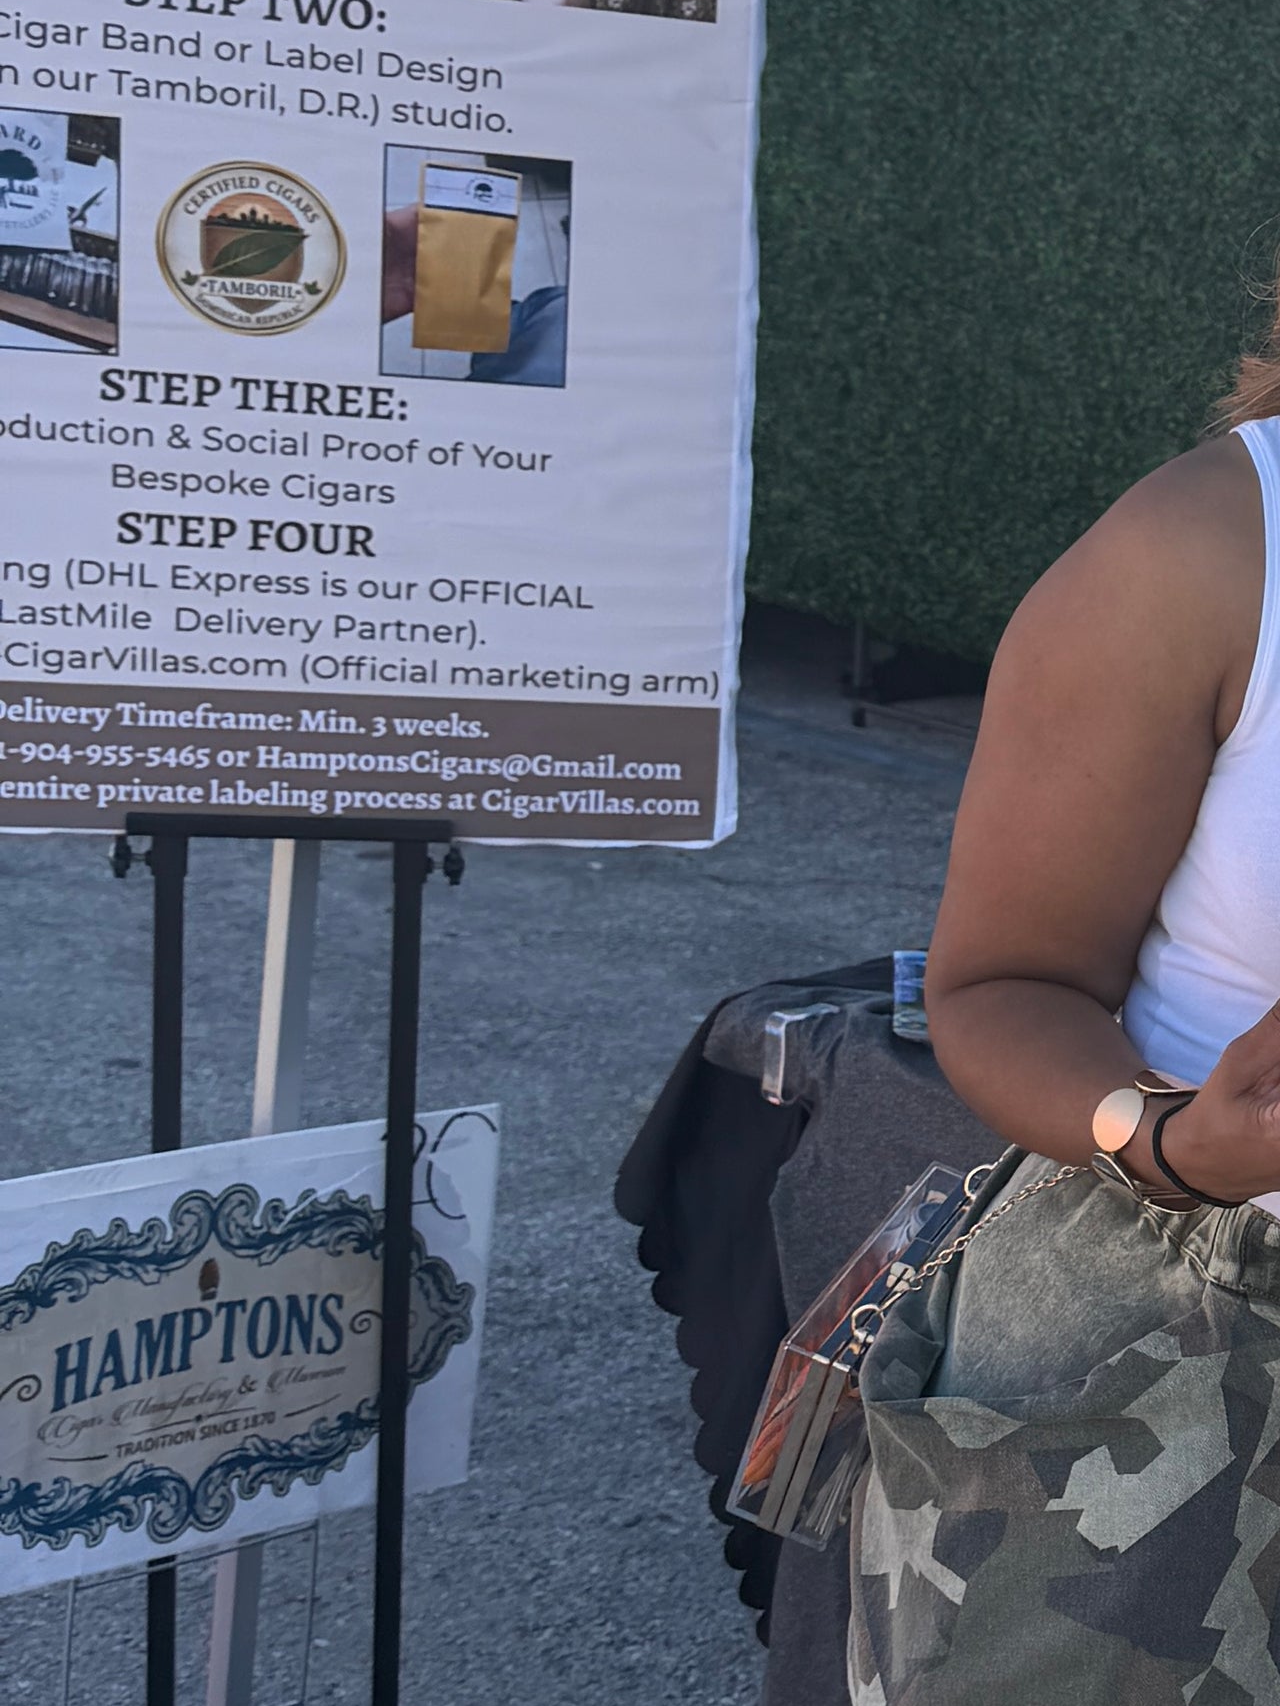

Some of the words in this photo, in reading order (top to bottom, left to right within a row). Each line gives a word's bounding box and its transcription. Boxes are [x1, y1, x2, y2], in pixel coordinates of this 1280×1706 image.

[0, 11, 89, 49] Cigar
[103, 23, 201, 59] Band
[214, 38, 251, 64] or
[265, 39, 363, 77] Label
[377, 51, 503, 92] Design
[33, 67, 98, 93] our
[108, 68, 286, 116] Tamboril,
[299, 89, 380, 127] D.R.)
[392, 98, 513, 135] studio.
[183, 175, 261, 216] CERTIFIED
[265, 180, 321, 224] CIGARS
[100, 368, 222, 408] STEP
[231, 376, 409, 422] THREE:
[0, 413, 154, 448] duction
[166, 424, 192, 450] &
[202, 425, 309, 458] Social
[323, 431, 418, 464] Proof
[428, 439, 465, 467] of
[471, 444, 553, 474] Your
[111, 463, 271, 501] Bespoke
[281, 474, 396, 507] Cigars
[117, 511, 237, 550] STEP
[249, 519, 376, 559] FOUR
[65, 558, 159, 591] (DHL
[171, 564, 310, 601] Express
[321, 571, 346, 599] is
[358, 578, 418, 603] our
[428, 578, 594, 612] OFFICIAL
[0, 598, 152, 630] LastMile
[174, 605, 322, 645] Delivery
[334, 614, 486, 649] Partner).
[300, 653, 437, 686] (Official
[450, 660, 630, 697] marketing
[642, 672, 720, 701] arm)
[116, 701, 292, 733] Timeframe:
[298, 710, 365, 735] Min.
[372, 718, 386, 738] 3
[394, 713, 489, 739] weeks.
[217, 749, 250, 768] or
[255, 746, 682, 781] HamptonsCigars@Gmail.com
[0, 775, 91, 800] entire
[97, 778, 204, 809] private
[209, 782, 327, 815] labeling
[334, 788, 442, 814] process
[448, 791, 475, 811] at
[481, 790, 701, 817] CigarVillas.com
[50, 1292, 344, 1414] HAMPTONS
[236, 1375, 257, 1395] &
[115, 1430, 197, 1459] TRADITION
[199, 1421, 239, 1442] SINCE
